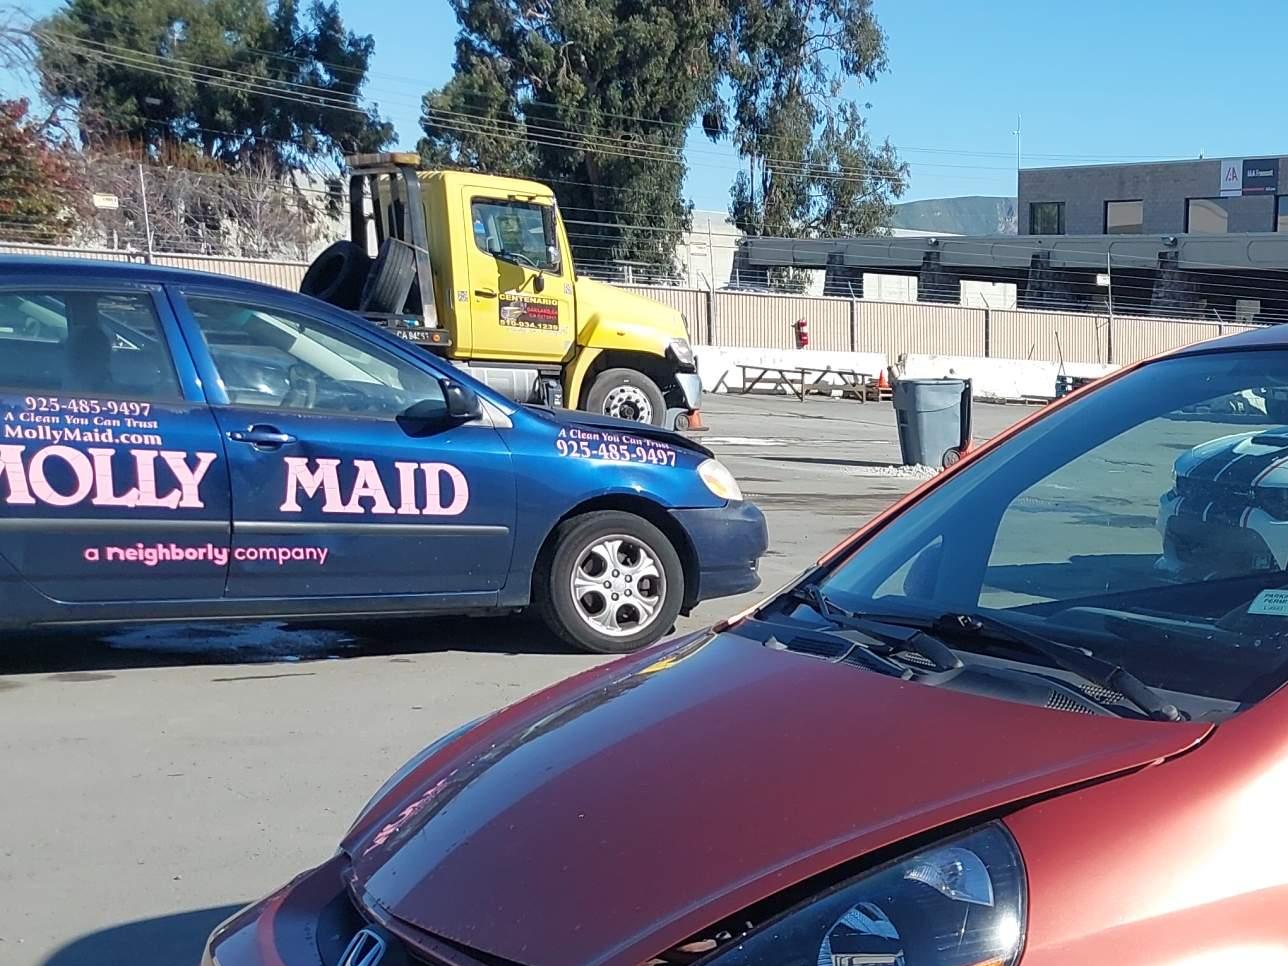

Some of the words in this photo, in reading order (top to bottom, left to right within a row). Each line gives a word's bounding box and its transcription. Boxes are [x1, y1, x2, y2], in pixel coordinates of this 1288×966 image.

[499, 293, 559, 306] CENTENARIO
[25, 397, 151, 417] 925-485-9497
[4, 411, 15, 422] A
[19, 411, 60, 424] Clean
[65, 415, 89, 425] You
[93, 416, 121, 427] Can
[124, 417, 158, 429] Trust
[4, 424, 162, 446] MollyMaid.com
[558, 428, 567, 438] A
[570, 428, 600, 440] Clean
[602, 432, 620, 443] You
[622, 435, 642, 445] Can
[556, 438, 676, 468] 925-485-9497
[280, 456, 469, 516] MAID
[84, 547, 99, 561] a
[106, 543, 229, 566] neighborly
[234, 547, 328, 565] company
